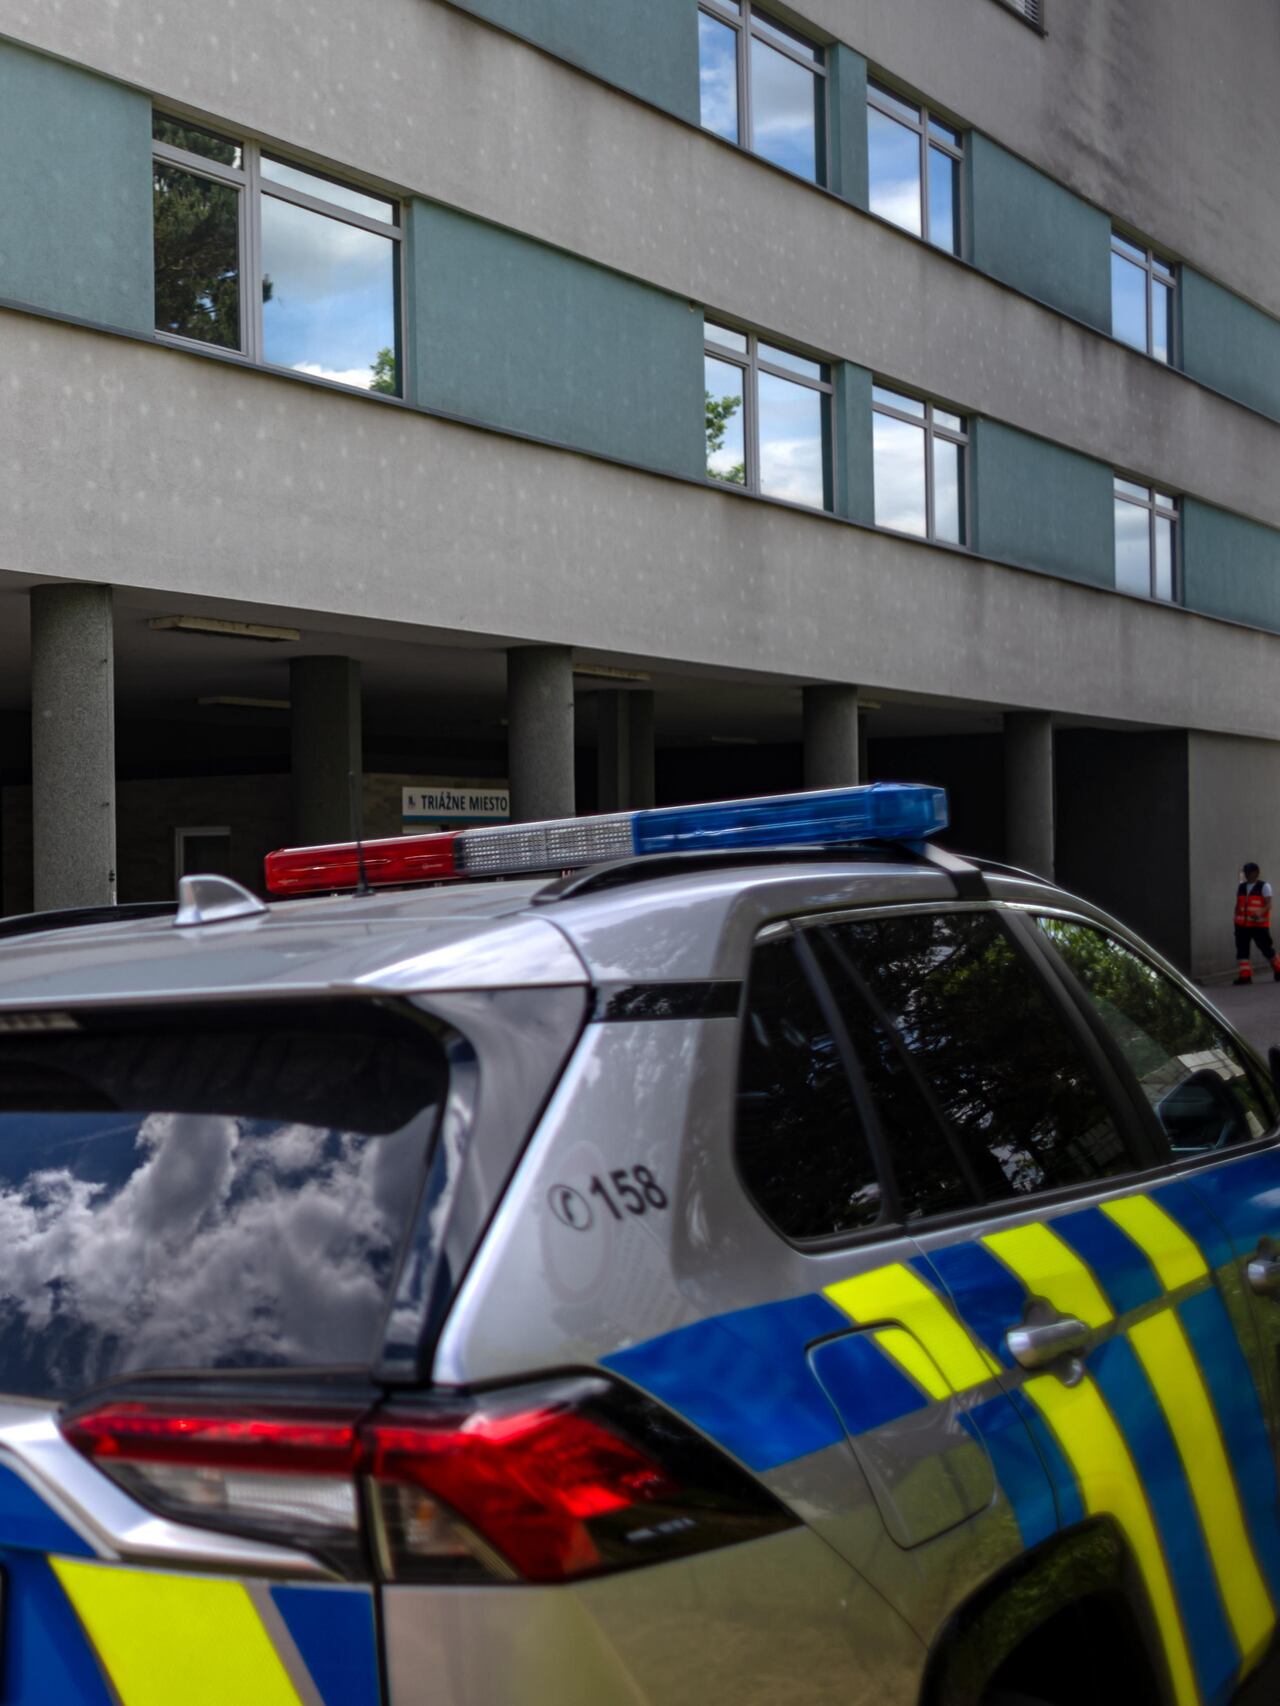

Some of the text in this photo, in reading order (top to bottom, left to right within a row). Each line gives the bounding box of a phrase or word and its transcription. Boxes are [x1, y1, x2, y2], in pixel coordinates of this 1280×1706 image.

[421, 791, 508, 811] TRIÁŽNE MIESTO
[590, 1164, 668, 1221] 158
